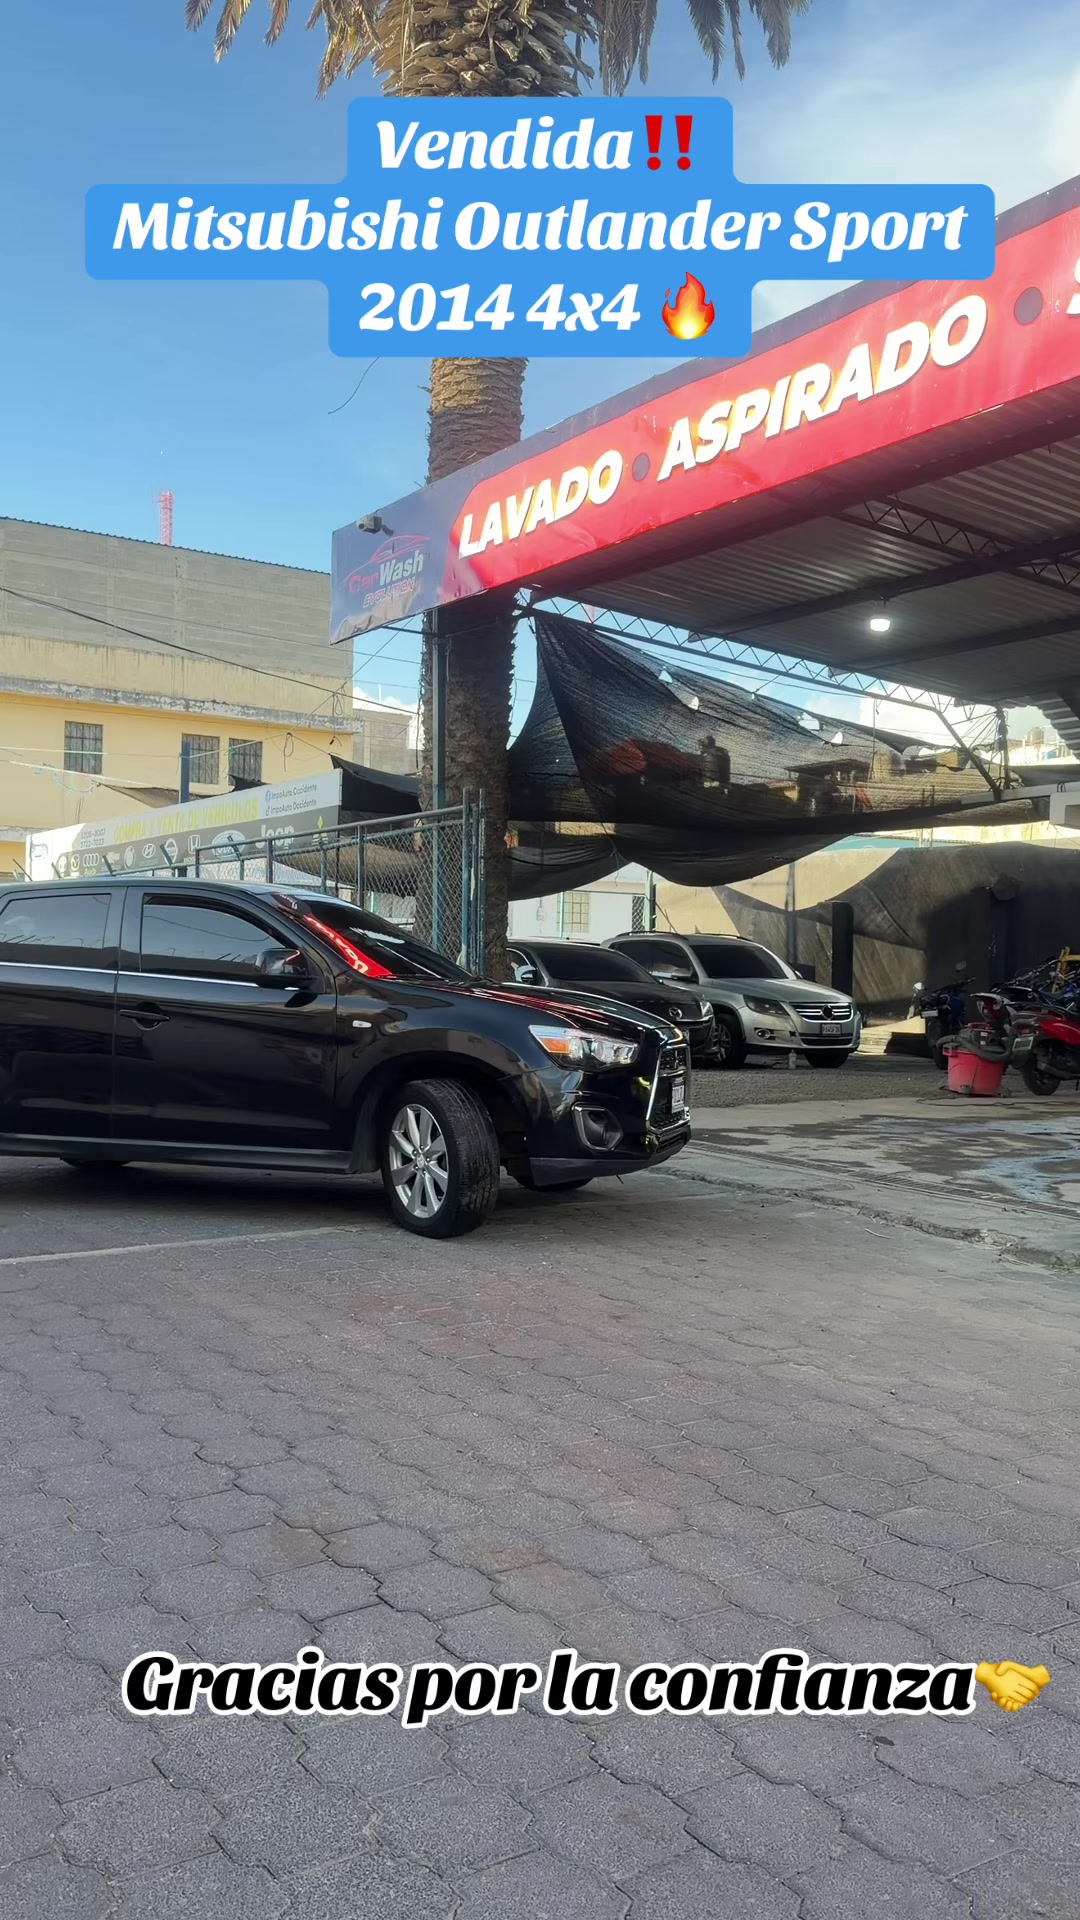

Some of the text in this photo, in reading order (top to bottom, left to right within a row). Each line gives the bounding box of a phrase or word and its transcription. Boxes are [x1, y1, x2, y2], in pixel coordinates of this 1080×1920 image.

[457, 293, 989, 560] LAVADO ASPIRADO
[380, 549, 424, 585] Wash
